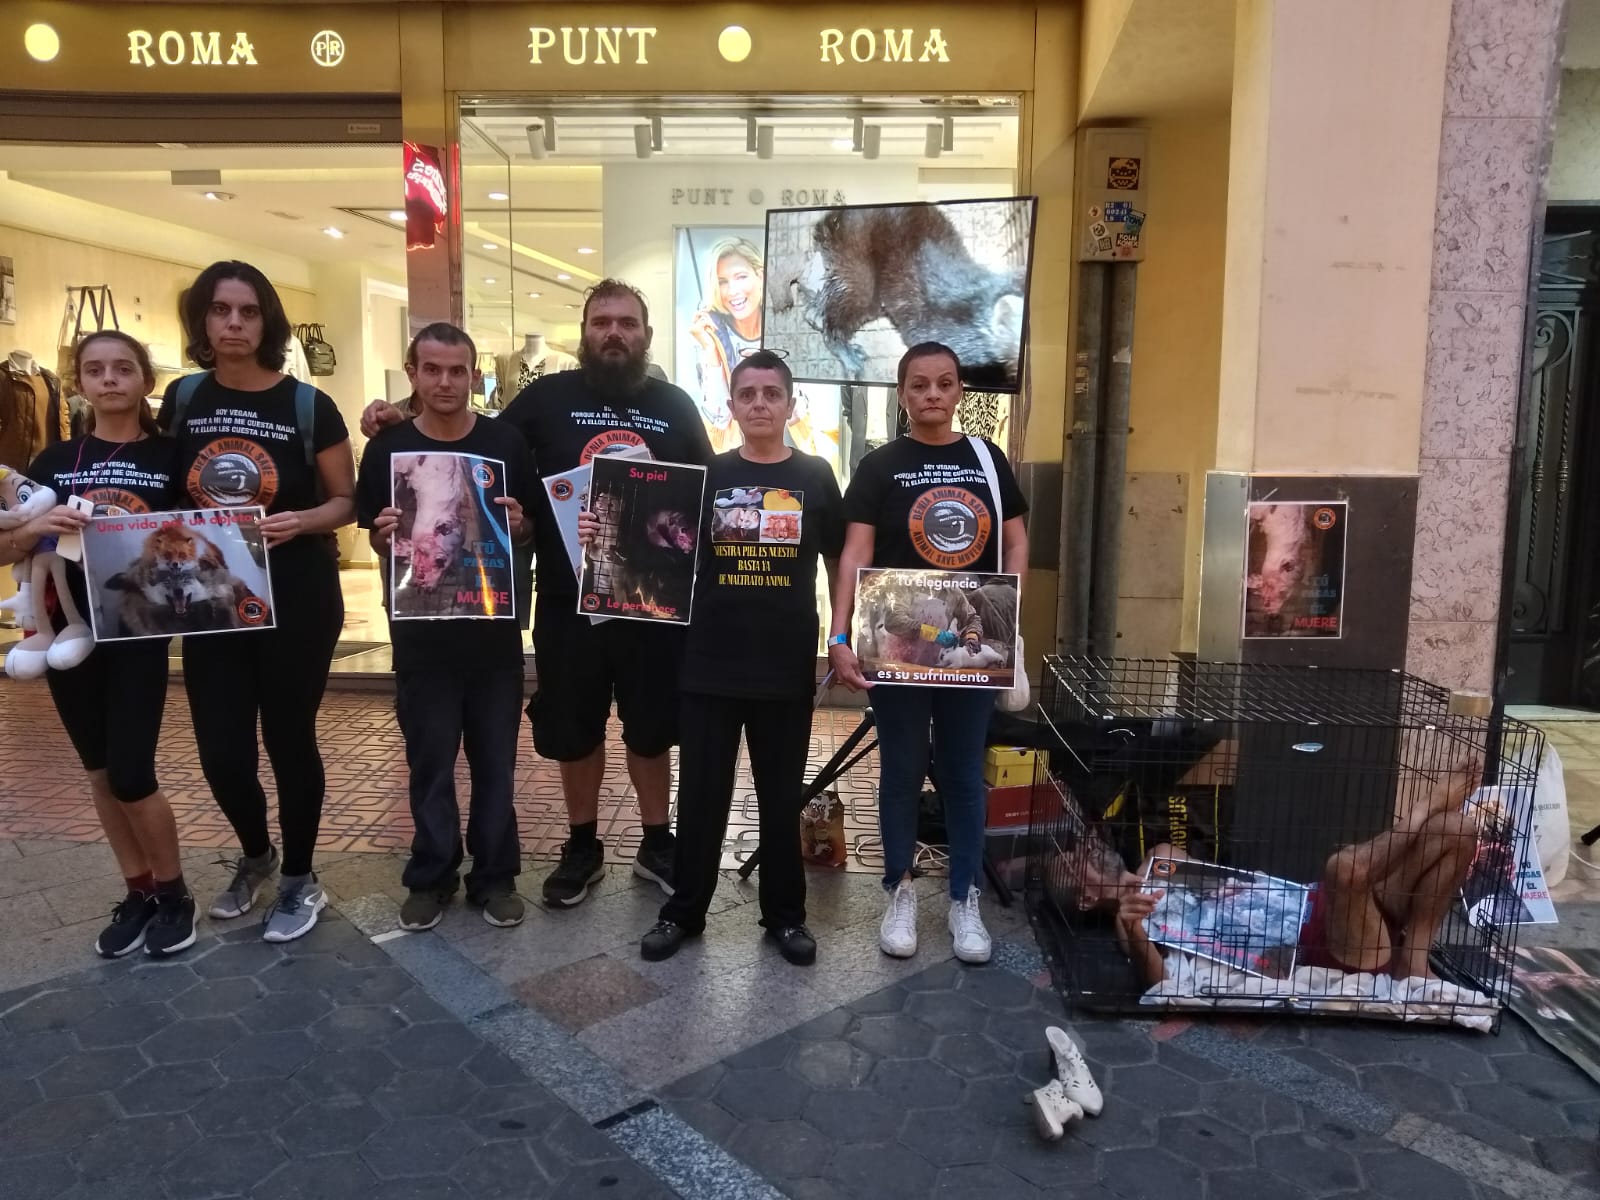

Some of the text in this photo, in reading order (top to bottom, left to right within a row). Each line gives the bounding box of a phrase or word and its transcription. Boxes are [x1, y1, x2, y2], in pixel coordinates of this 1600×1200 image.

[128, 29, 258, 67] ROMA
[528, 26, 951, 65] PUNT ROMA
[671, 187, 847, 206] PUNT ROMA
[215, 408, 258, 419] SOY VEGANA
[208, 417, 213, 425] A
[234, 417, 246, 426] ME
[247, 419, 274, 430] CUESTA
[275, 424, 296, 434] NADA
[194, 426, 200, 434] A
[200, 425, 218, 433] ELLOS
[218, 425, 230, 433] LES
[231, 426, 258, 436] CUESTA
[260, 430, 270, 438] LA
[271, 431, 289, 441] VIDA
[217, 439, 255, 454] ANIMAL
[109, 477, 137, 485] CUESTA
[125, 470, 152, 480] CUESTA
[629, 467, 668, 482] Su piel
[893, 472, 917, 480] PORQUE
[904, 480, 911, 488] A
[910, 477, 930, 487] ELLOS
[931, 488, 967, 501] ANIMAL
[967, 498, 988, 518] SAVE
[96, 520, 125, 533] Una
[127, 518, 158, 531] vida
[742, 545, 758, 557] PIEL
[759, 546, 768, 558] ES
[738, 559, 771, 572] BASTA YA
[935, 554, 956, 566] SAVE
[764, 575, 791, 587] ANIMAL
[915, 577, 978, 591] elegancia
[1294, 617, 1337, 628] MUERE
[877, 668, 990, 683] es su sufrimiento
